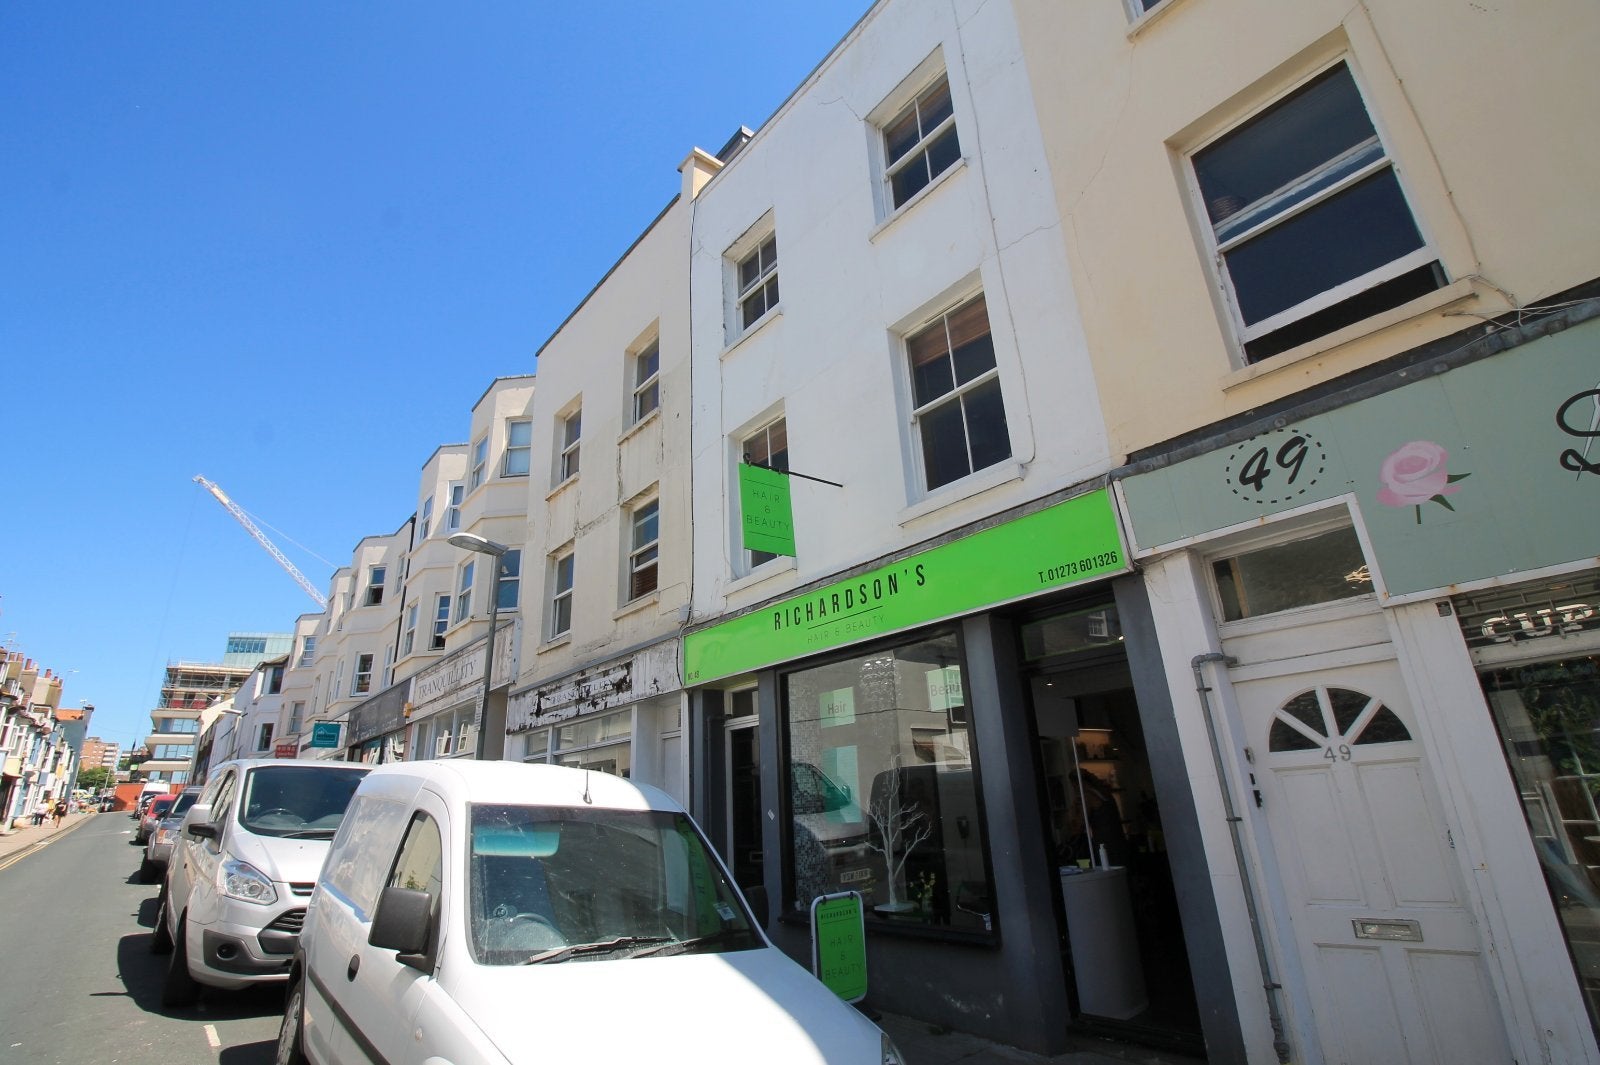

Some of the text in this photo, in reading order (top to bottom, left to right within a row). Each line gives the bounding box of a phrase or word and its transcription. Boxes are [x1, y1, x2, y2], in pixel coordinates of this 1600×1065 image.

[1238, 436, 1306, 492] 49
[752, 488, 780, 503] HAIR
[764, 505, 771, 514] &
[746, 514, 790, 531] BEAUTY
[1038, 551, 1118, 583] T. 01273 601326
[774, 564, 926, 631] RICHARDSON'S
[807, 630, 829, 644] HAIR
[845, 615, 887, 634] BEAUTY
[827, 702, 847, 715] Hair
[1323, 744, 1351, 763] 49
[830, 934, 854, 947] HAIR
[825, 962, 862, 979] BEAUTY
